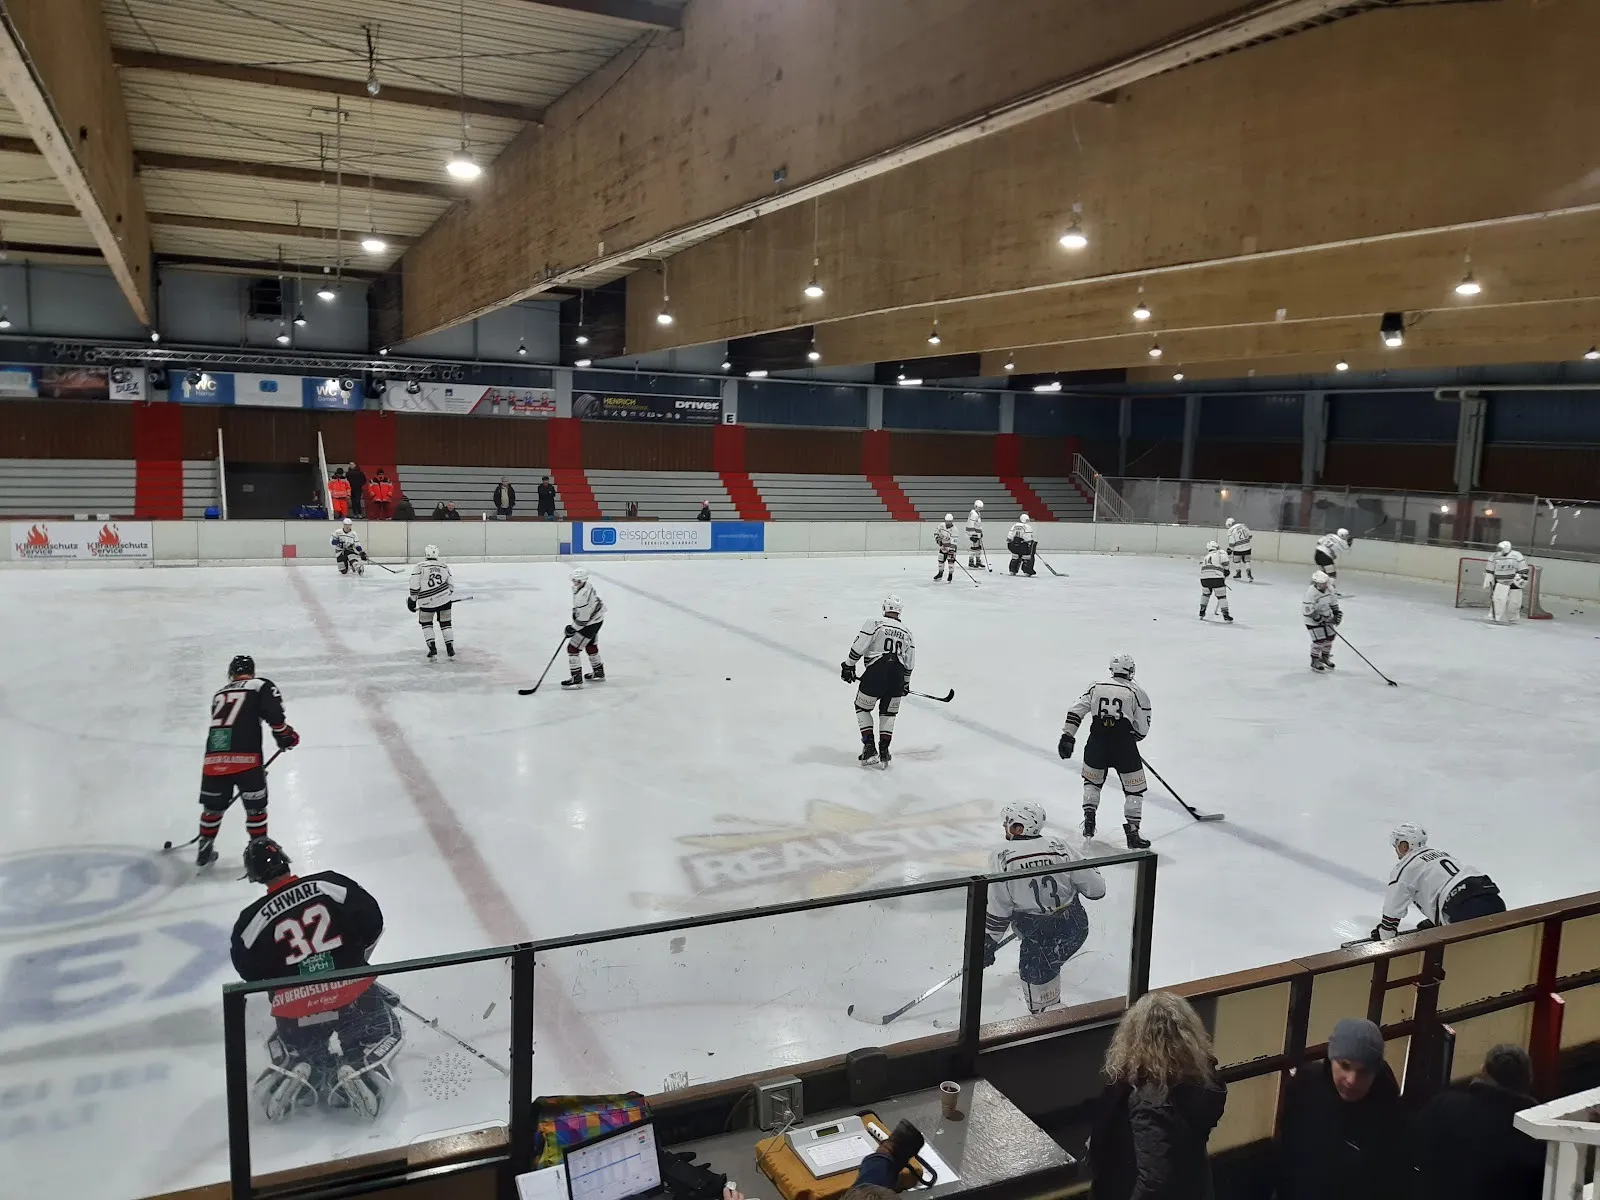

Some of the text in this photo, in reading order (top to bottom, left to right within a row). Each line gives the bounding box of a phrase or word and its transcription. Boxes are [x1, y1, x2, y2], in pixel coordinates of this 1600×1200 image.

[196, 380, 217, 391] WC
[316, 385, 337, 396] WC
[726, 414, 735, 424] E
[619, 528, 698, 545] eissportarena
[20, 549, 53, 558] Service
[91, 548, 123, 557] Service
[427, 573, 443, 588] 89
[210, 690, 247, 726] 27
[1099, 697, 1125, 720] 63
[260, 881, 321, 921] SCHWARZ
[1028, 875, 1061, 914] 13
[274, 904, 344, 966] 32
